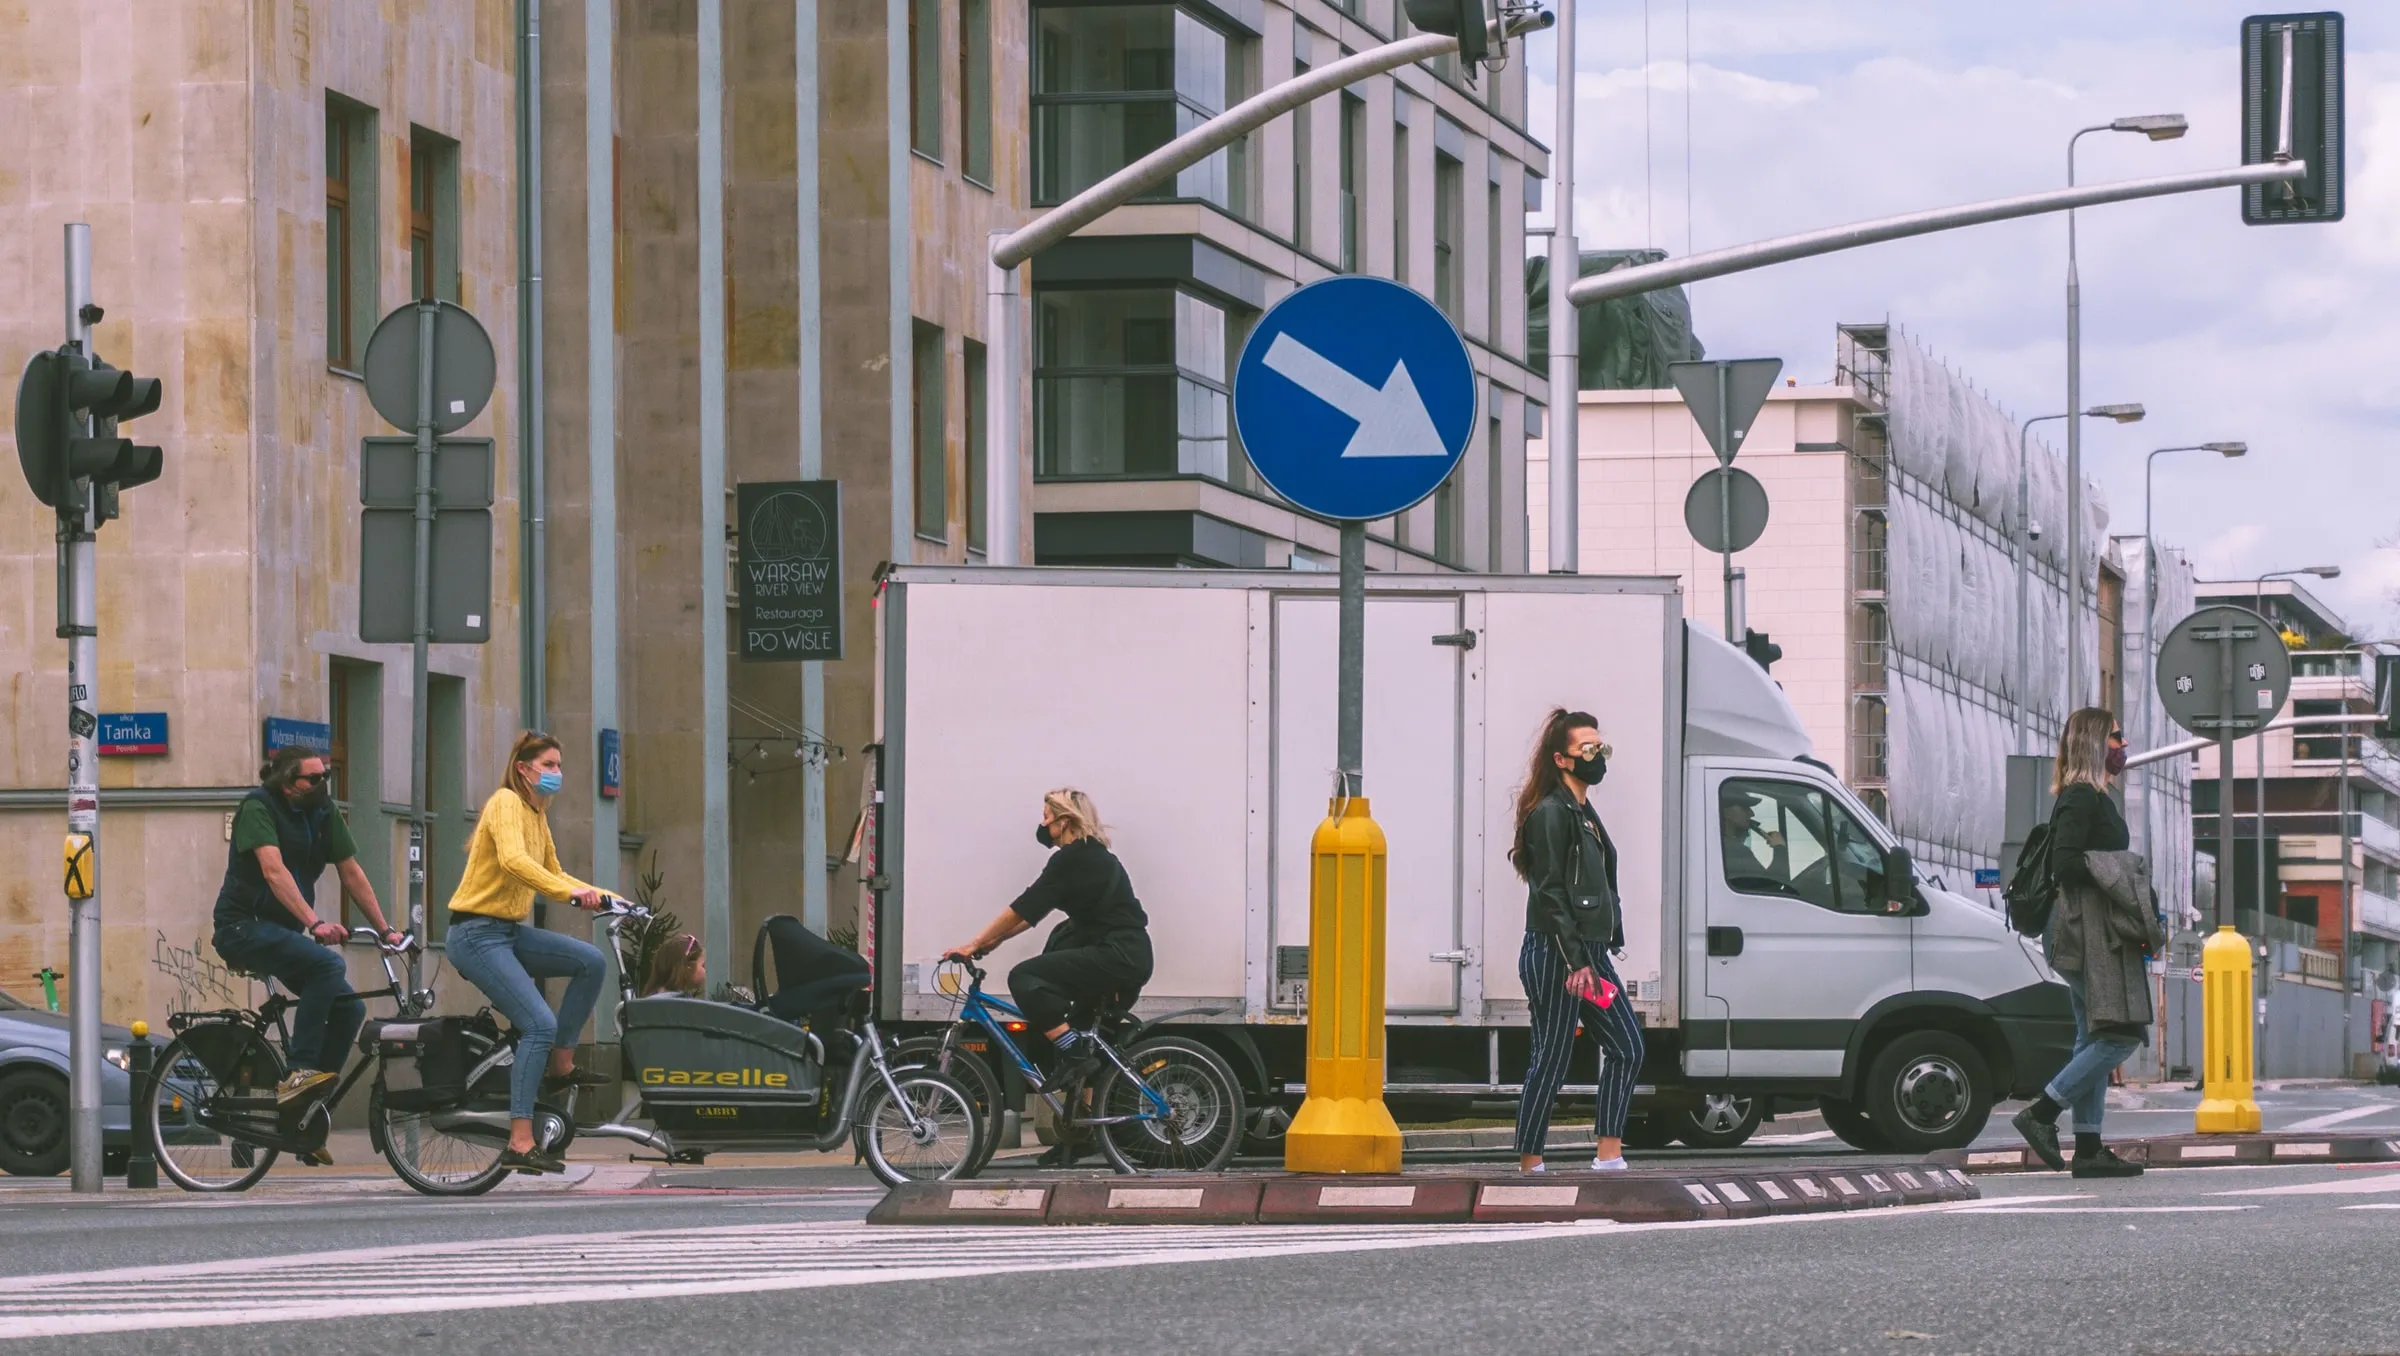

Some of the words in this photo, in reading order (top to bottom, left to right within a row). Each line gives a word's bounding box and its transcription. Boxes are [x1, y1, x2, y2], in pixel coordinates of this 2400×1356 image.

[748, 561, 830, 583] WARSAW
[755, 583, 789, 597] RIVER
[795, 581, 825, 596] VIEW
[755, 606, 824, 623] Restauracja
[748, 631, 779, 652] PO
[104, 723, 151, 741] Tamka
[608, 751, 620, 784] 43
[642, 1067, 789, 1087] Gazelle
